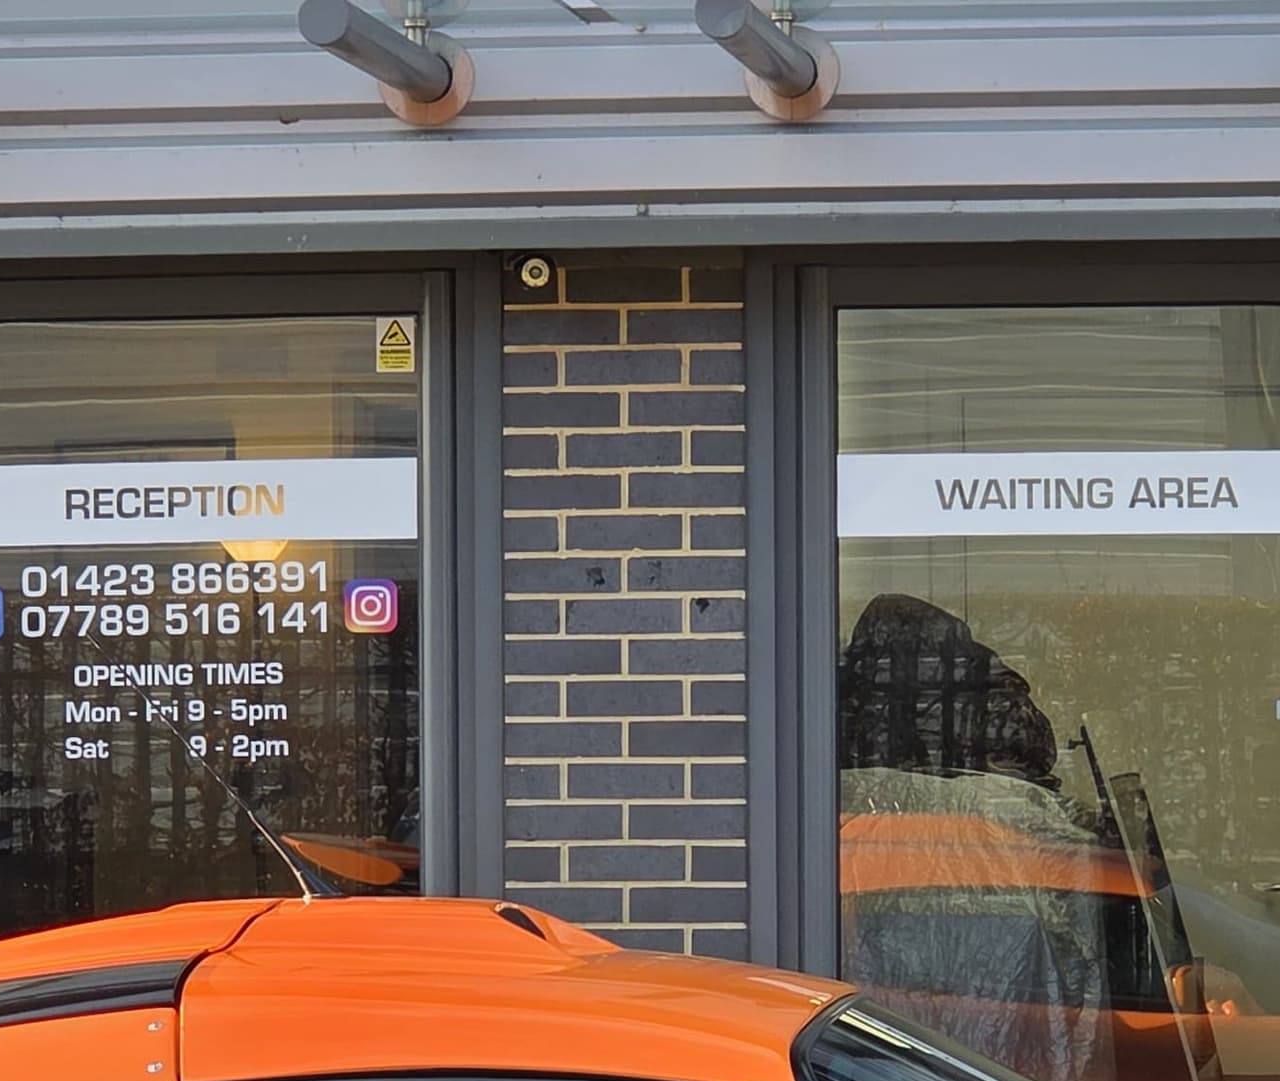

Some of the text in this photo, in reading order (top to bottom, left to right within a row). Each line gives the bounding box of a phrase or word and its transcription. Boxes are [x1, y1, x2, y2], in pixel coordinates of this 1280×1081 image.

[65, 484, 285, 520] RECEPTION
[934, 477, 1239, 510] WAITING AREA
[22, 559, 327, 598] 01423 866391
[21, 601, 328, 638] 07789 516 141
[74, 662, 284, 687] OPENING TIMES
[66, 701, 121, 723] Mon
[145, 698, 179, 722] Fri
[188, 699, 205, 721] 9
[231, 698, 287, 727] 5pm
[65, 736, 109, 759] Sat
[189, 735, 207, 758] 9
[232, 734, 289, 763] 2pm
